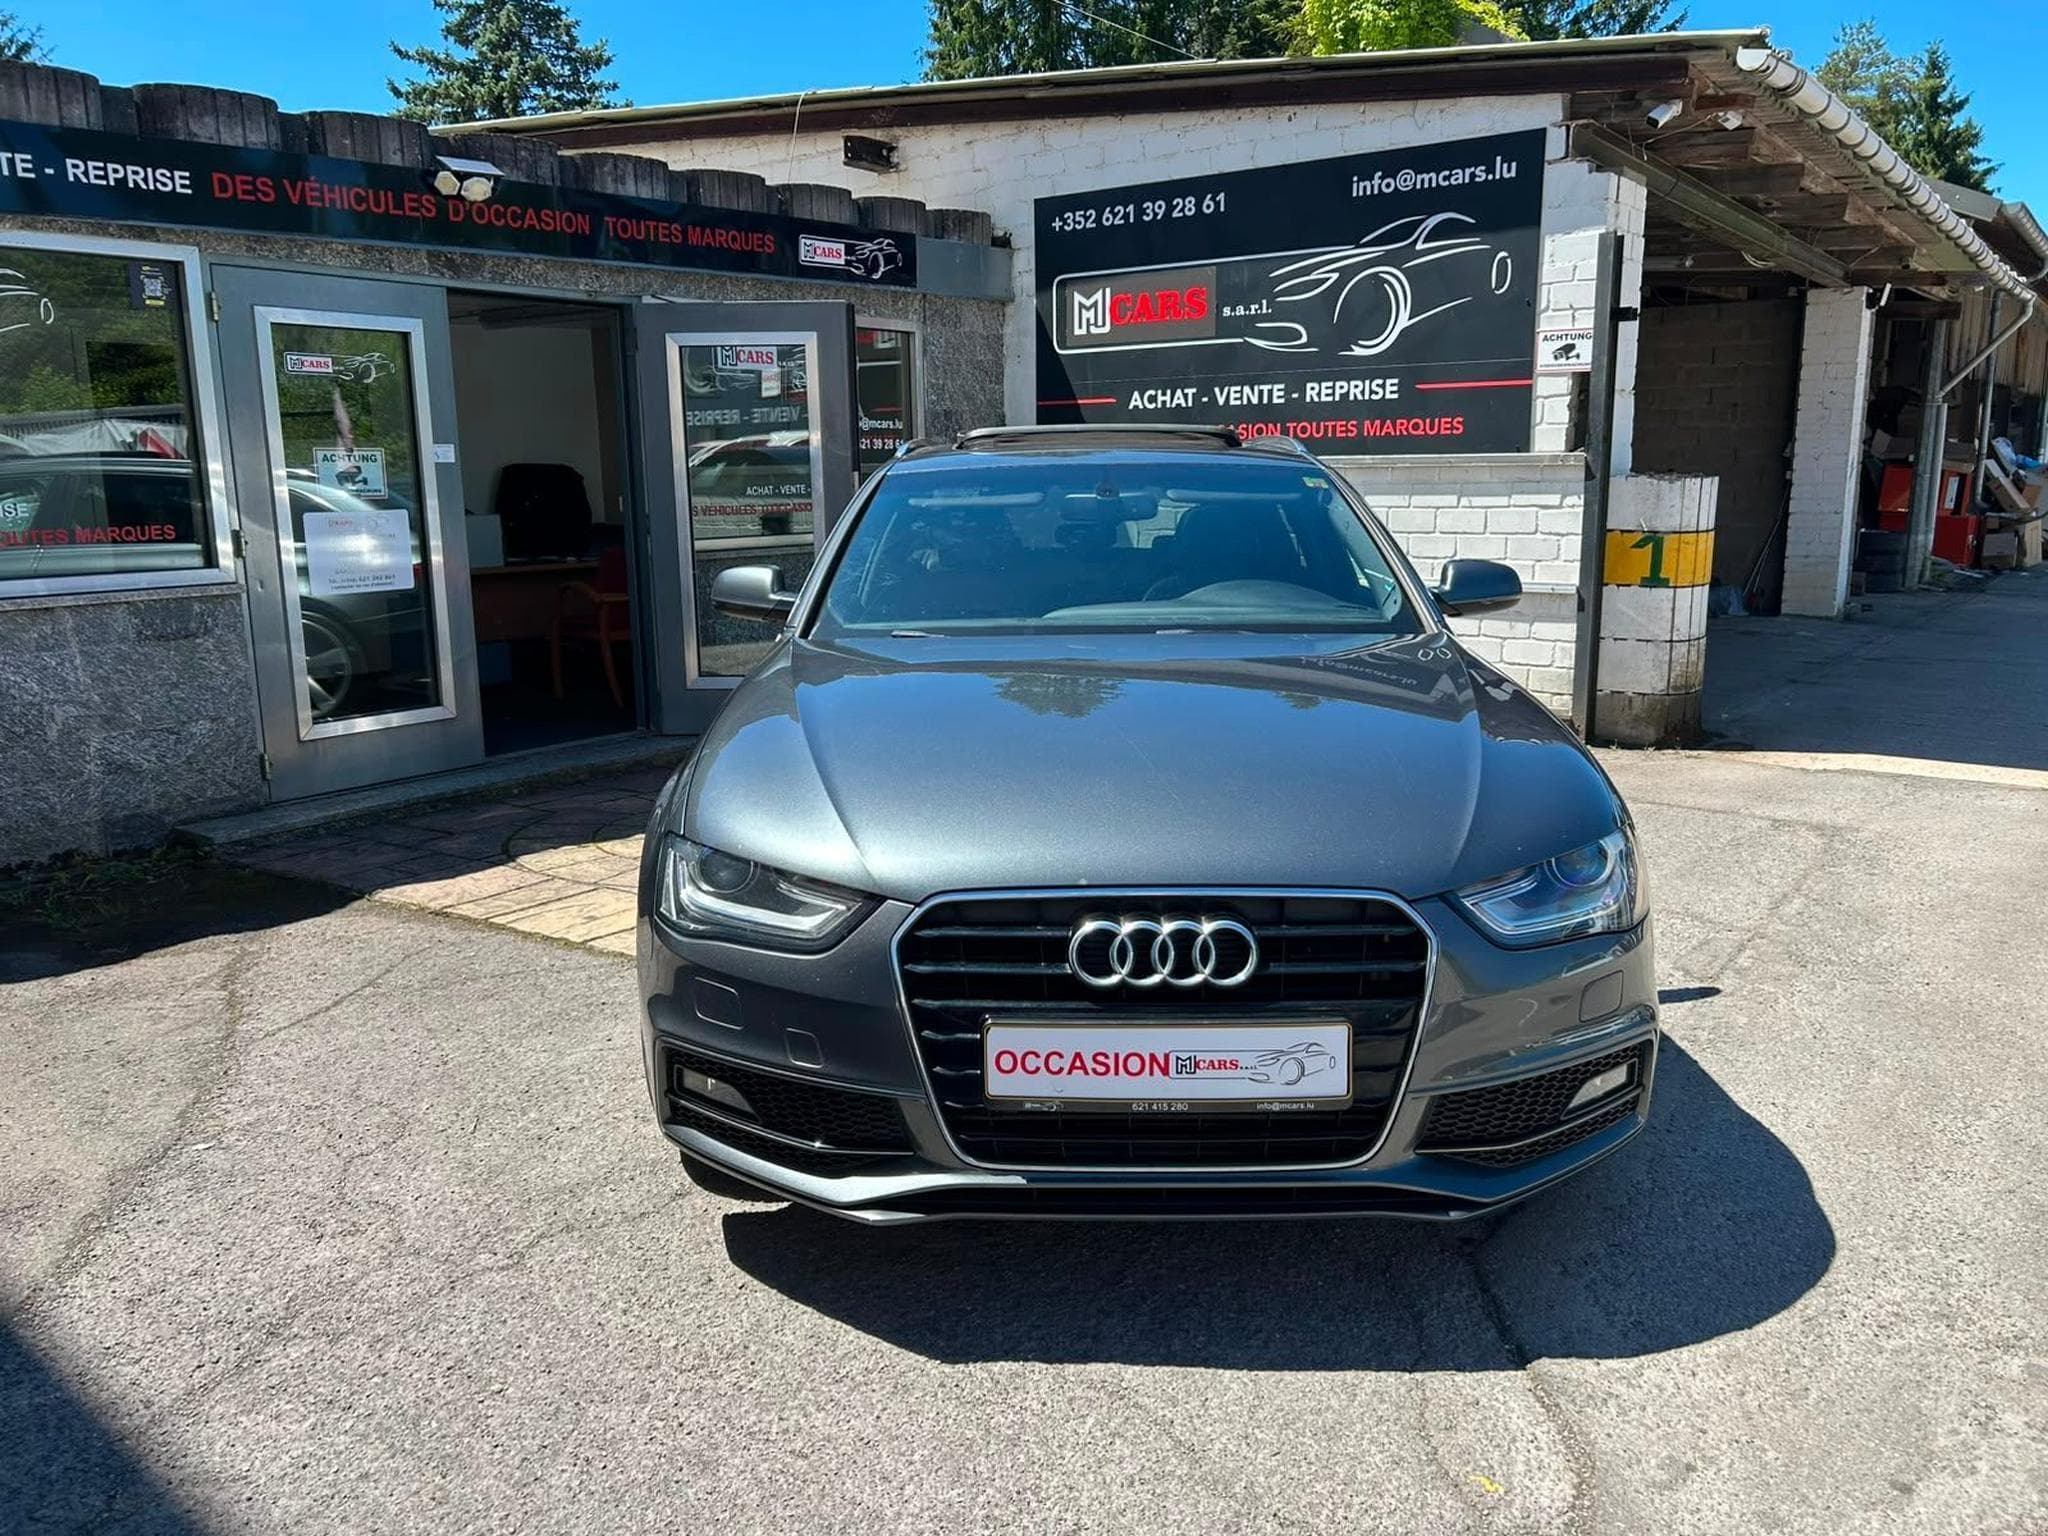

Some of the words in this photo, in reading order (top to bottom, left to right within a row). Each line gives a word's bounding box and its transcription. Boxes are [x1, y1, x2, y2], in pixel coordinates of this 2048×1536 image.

[1351, 155, 1518, 198] info@mcars.lu
[65, 157, 193, 195] REPRISE
[212, 172, 276, 203] DES
[283, 175, 438, 218] VÉHICULES
[448, 199, 590, 235] D'OCCASION
[604, 216, 682, 245] TOUTES
[688, 225, 777, 254] MARQUES
[1051, 208, 1097, 232] +352
[1101, 203, 1135, 227] 621
[1142, 200, 1167, 221] 39
[1172, 196, 1196, 218] 28
[1202, 191, 1226, 214] 61
[1222, 299, 1273, 318] s.a.r.l.
[1542, 332, 1593, 342] ACHTUNG
[1127, 387, 1198, 411] ACHAT
[1213, 383, 1286, 407] VENTE
[1305, 377, 1400, 403] REPRISE
[1286, 419, 1358, 440] TOUTES
[1363, 415, 1464, 437] MARQUES
[322, 453, 378, 464] ACHTUNG
[746, 486, 774, 496] ACHAT
[780, 484, 807, 495] VENTE
[75, 524, 177, 544] MARQUES
[1630, 532, 1671, 588] 1
[994, 1050, 1170, 1078] OCCASION
[1132, 1102, 1149, 1112] 621
[1152, 1102, 1169, 1112] 415
[1256, 1101, 1315, 1113] info@mcars.lu
